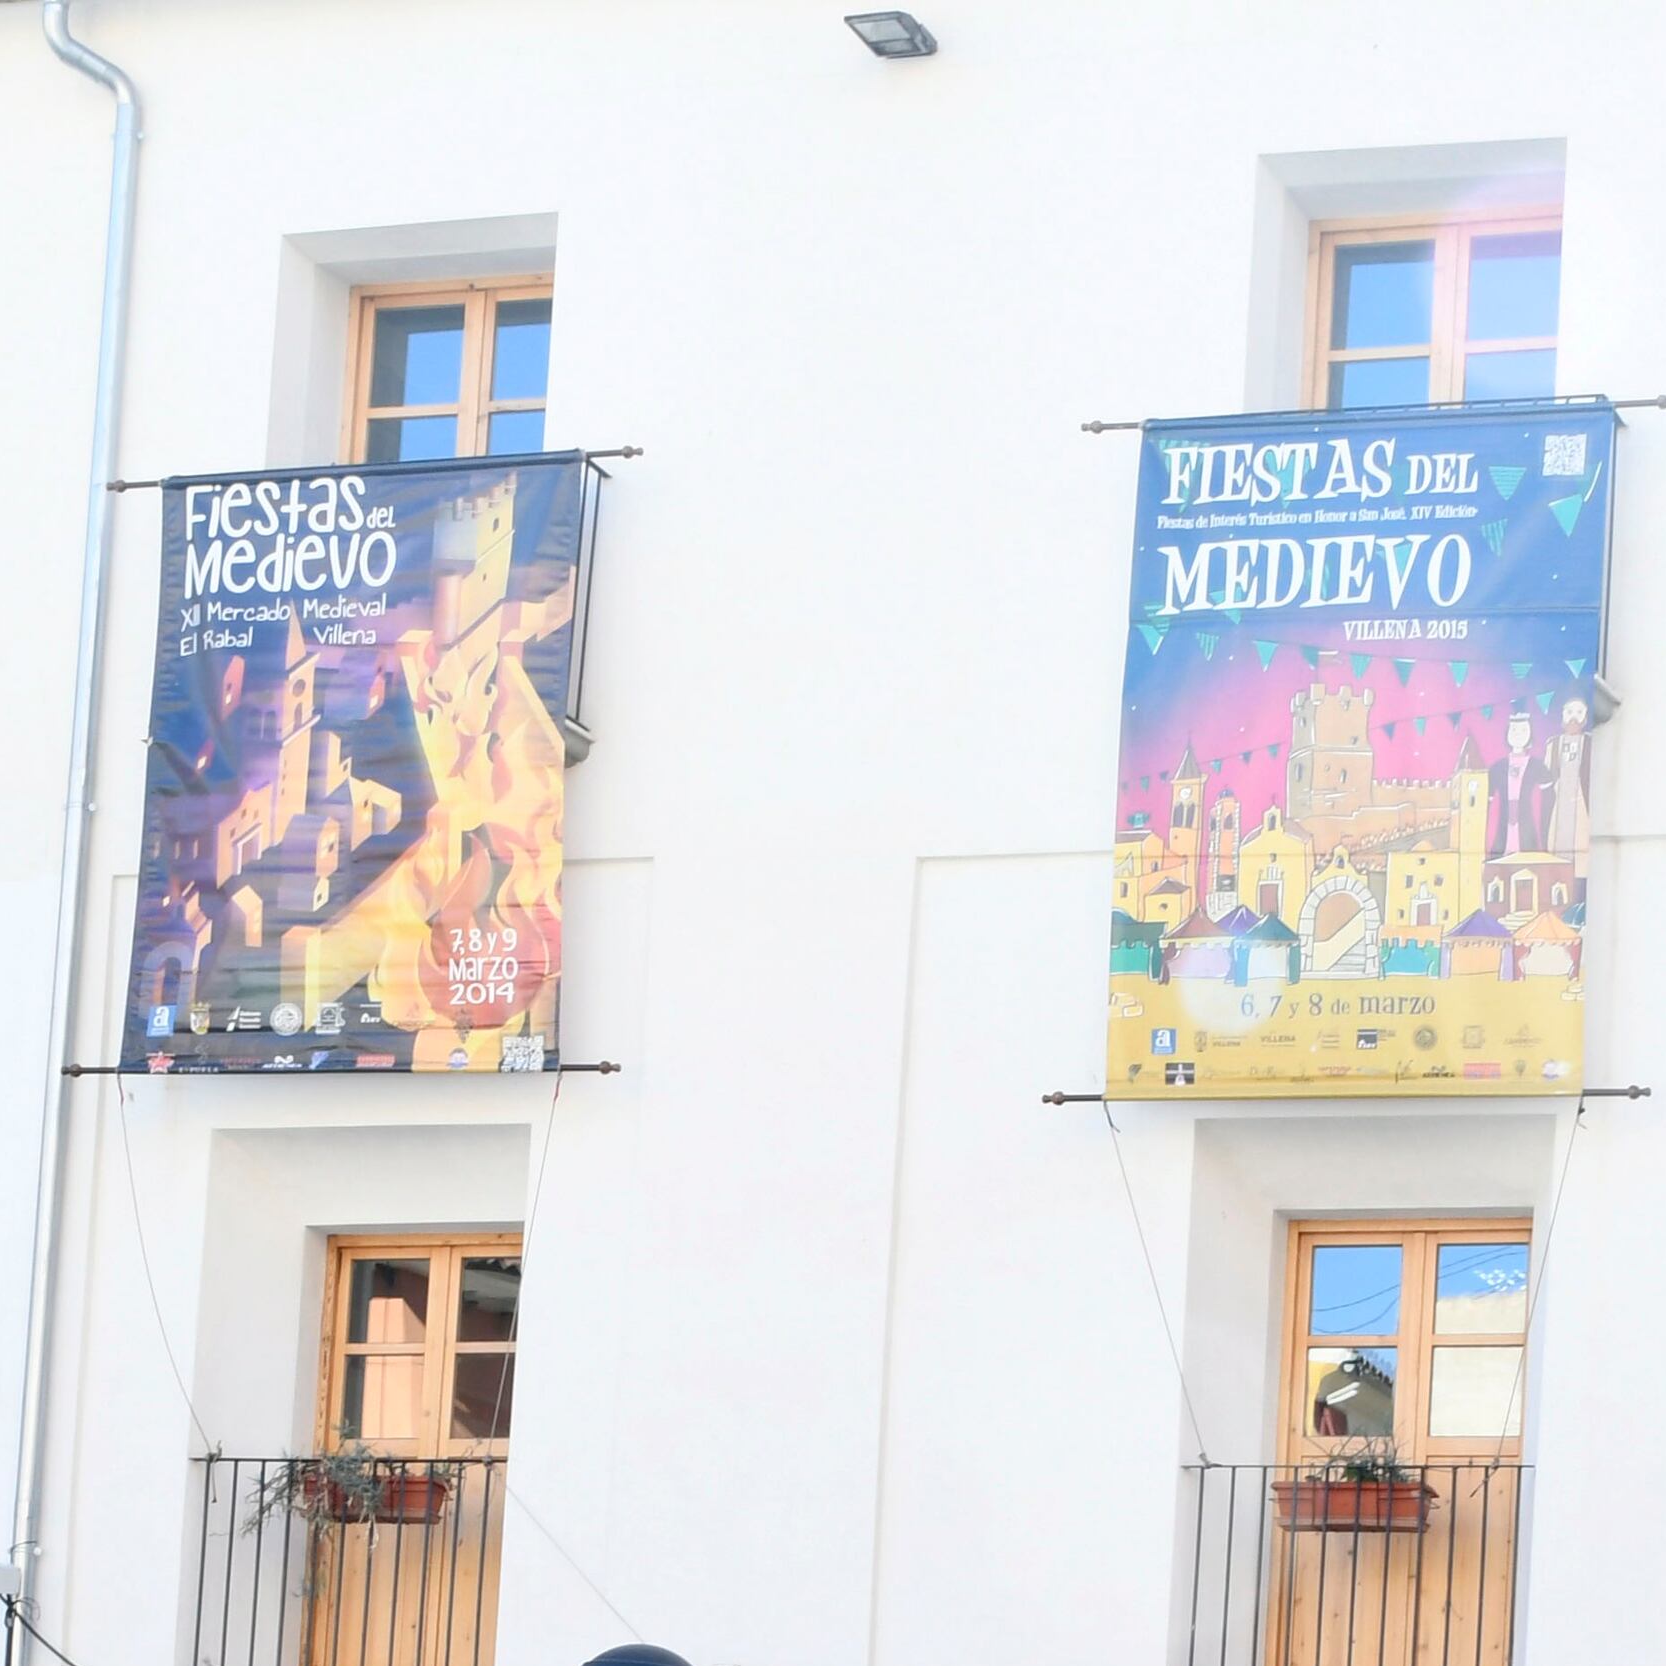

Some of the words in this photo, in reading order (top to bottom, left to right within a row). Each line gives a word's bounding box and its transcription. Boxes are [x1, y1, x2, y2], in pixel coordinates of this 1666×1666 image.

[1161, 438, 1395, 507] FIESTAS
[1404, 453, 1478, 494] DEL
[186, 475, 366, 541] Fiestas
[1157, 515, 1194, 529] Fiestas
[1196, 515, 1208, 528] de
[1298, 513, 1310, 524] en
[1314, 509, 1347, 524] Honor
[1349, 512, 1356, 521] a
[1358, 509, 1378, 521] San
[1410, 506, 1431, 520] XIV
[184, 531, 397, 599] Medievo
[1156, 534, 1471, 616] MEDIEVO
[207, 597, 290, 622] Mercado
[303, 592, 386, 619] Medieval
[180, 632, 198, 657] El
[203, 626, 254, 650] Rabal
[313, 624, 376, 644] Villena
[1344, 618, 1422, 641] VILLENA
[1426, 620, 1468, 640] 2015
[486, 932, 497, 954] y
[502, 928, 517, 951] 9
[449, 956, 518, 981] Marzo
[449, 982, 515, 1005] 2014
[1270, 996, 1282, 1018] 7
[1289, 1003, 1299, 1019] y
[1309, 993, 1323, 1016] 8
[1331, 998, 1350, 1015] de
[1359, 995, 1435, 1015] marzo
